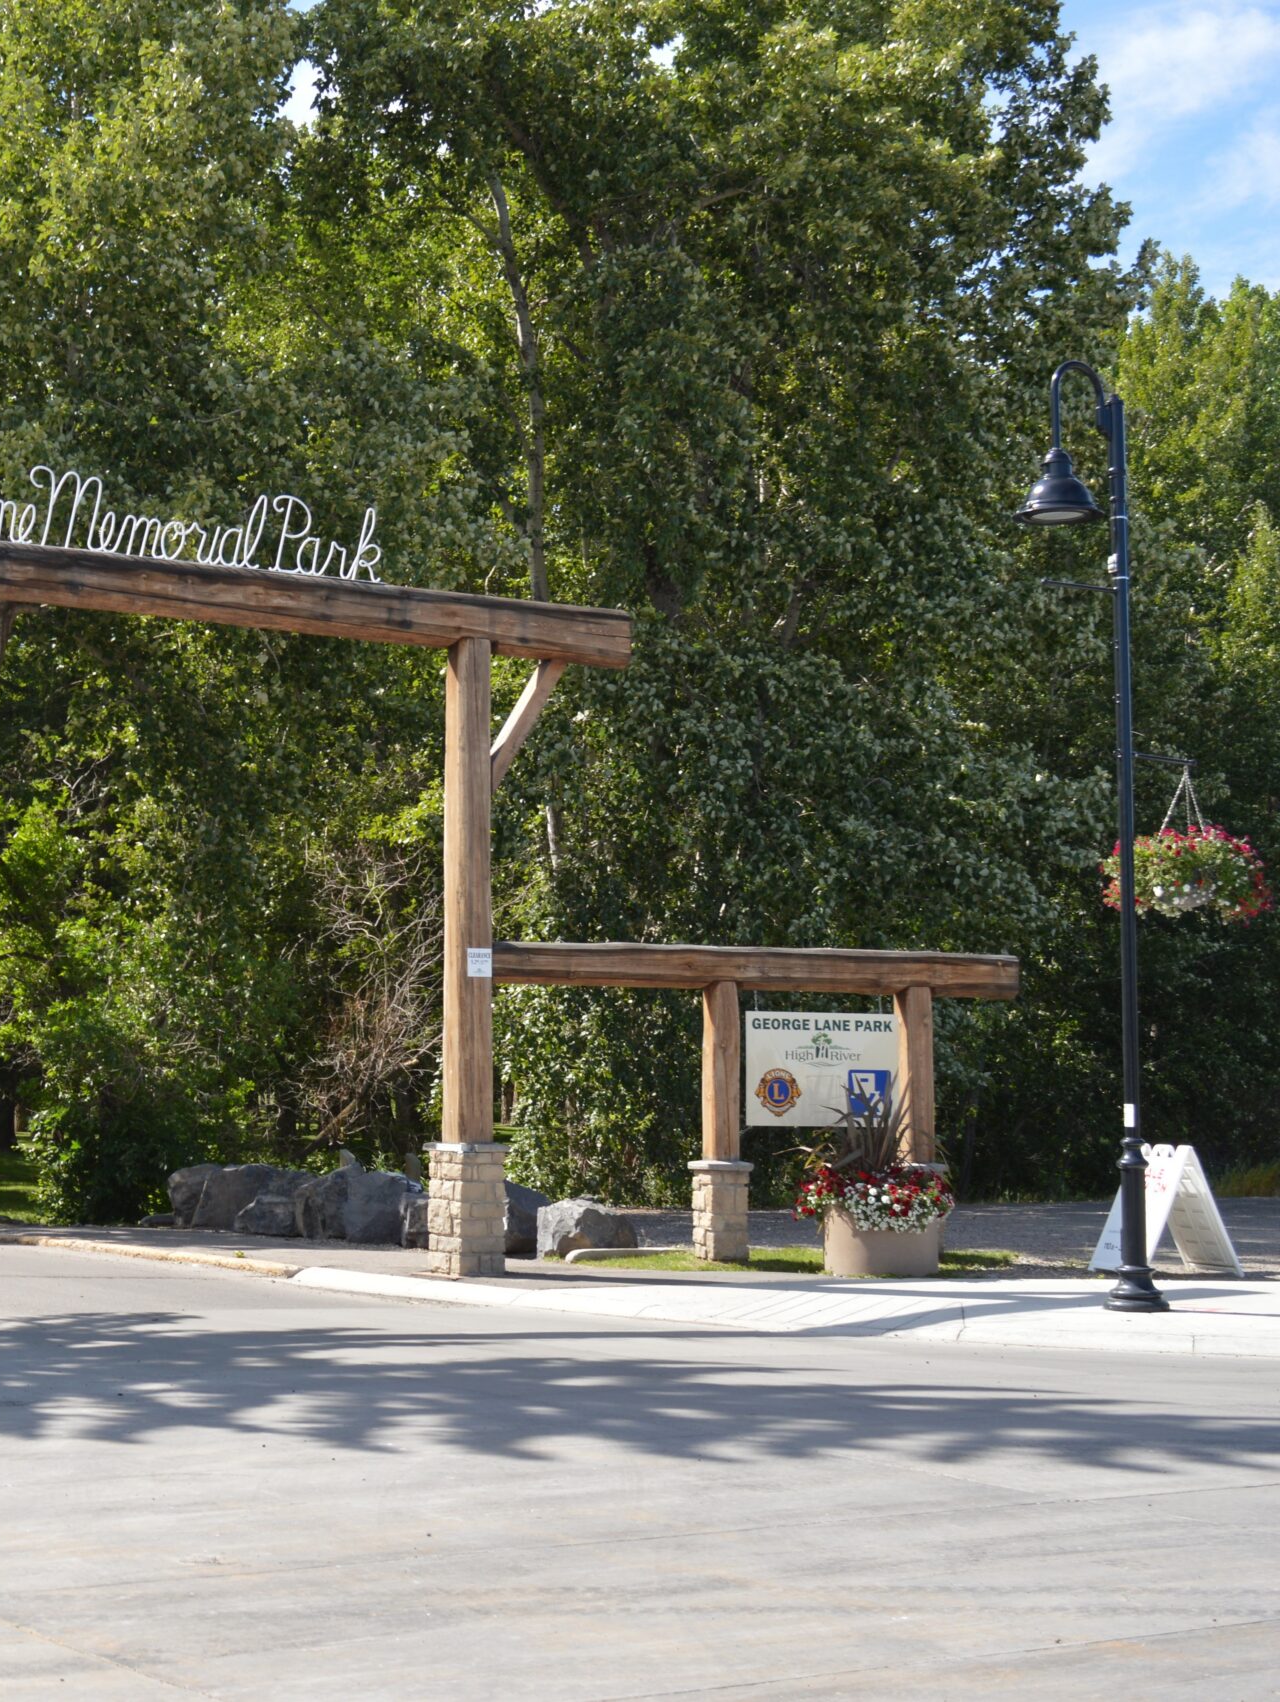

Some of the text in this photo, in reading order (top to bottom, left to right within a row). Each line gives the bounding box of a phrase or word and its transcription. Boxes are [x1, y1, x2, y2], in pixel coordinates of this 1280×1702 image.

[28, 465, 268, 570] Memorial
[267, 494, 382, 582] Park
[752, 1017, 893, 1032] GEORGE LANE PARK
[785, 1050, 862, 1062] High River
[773, 1083, 785, 1100] L
